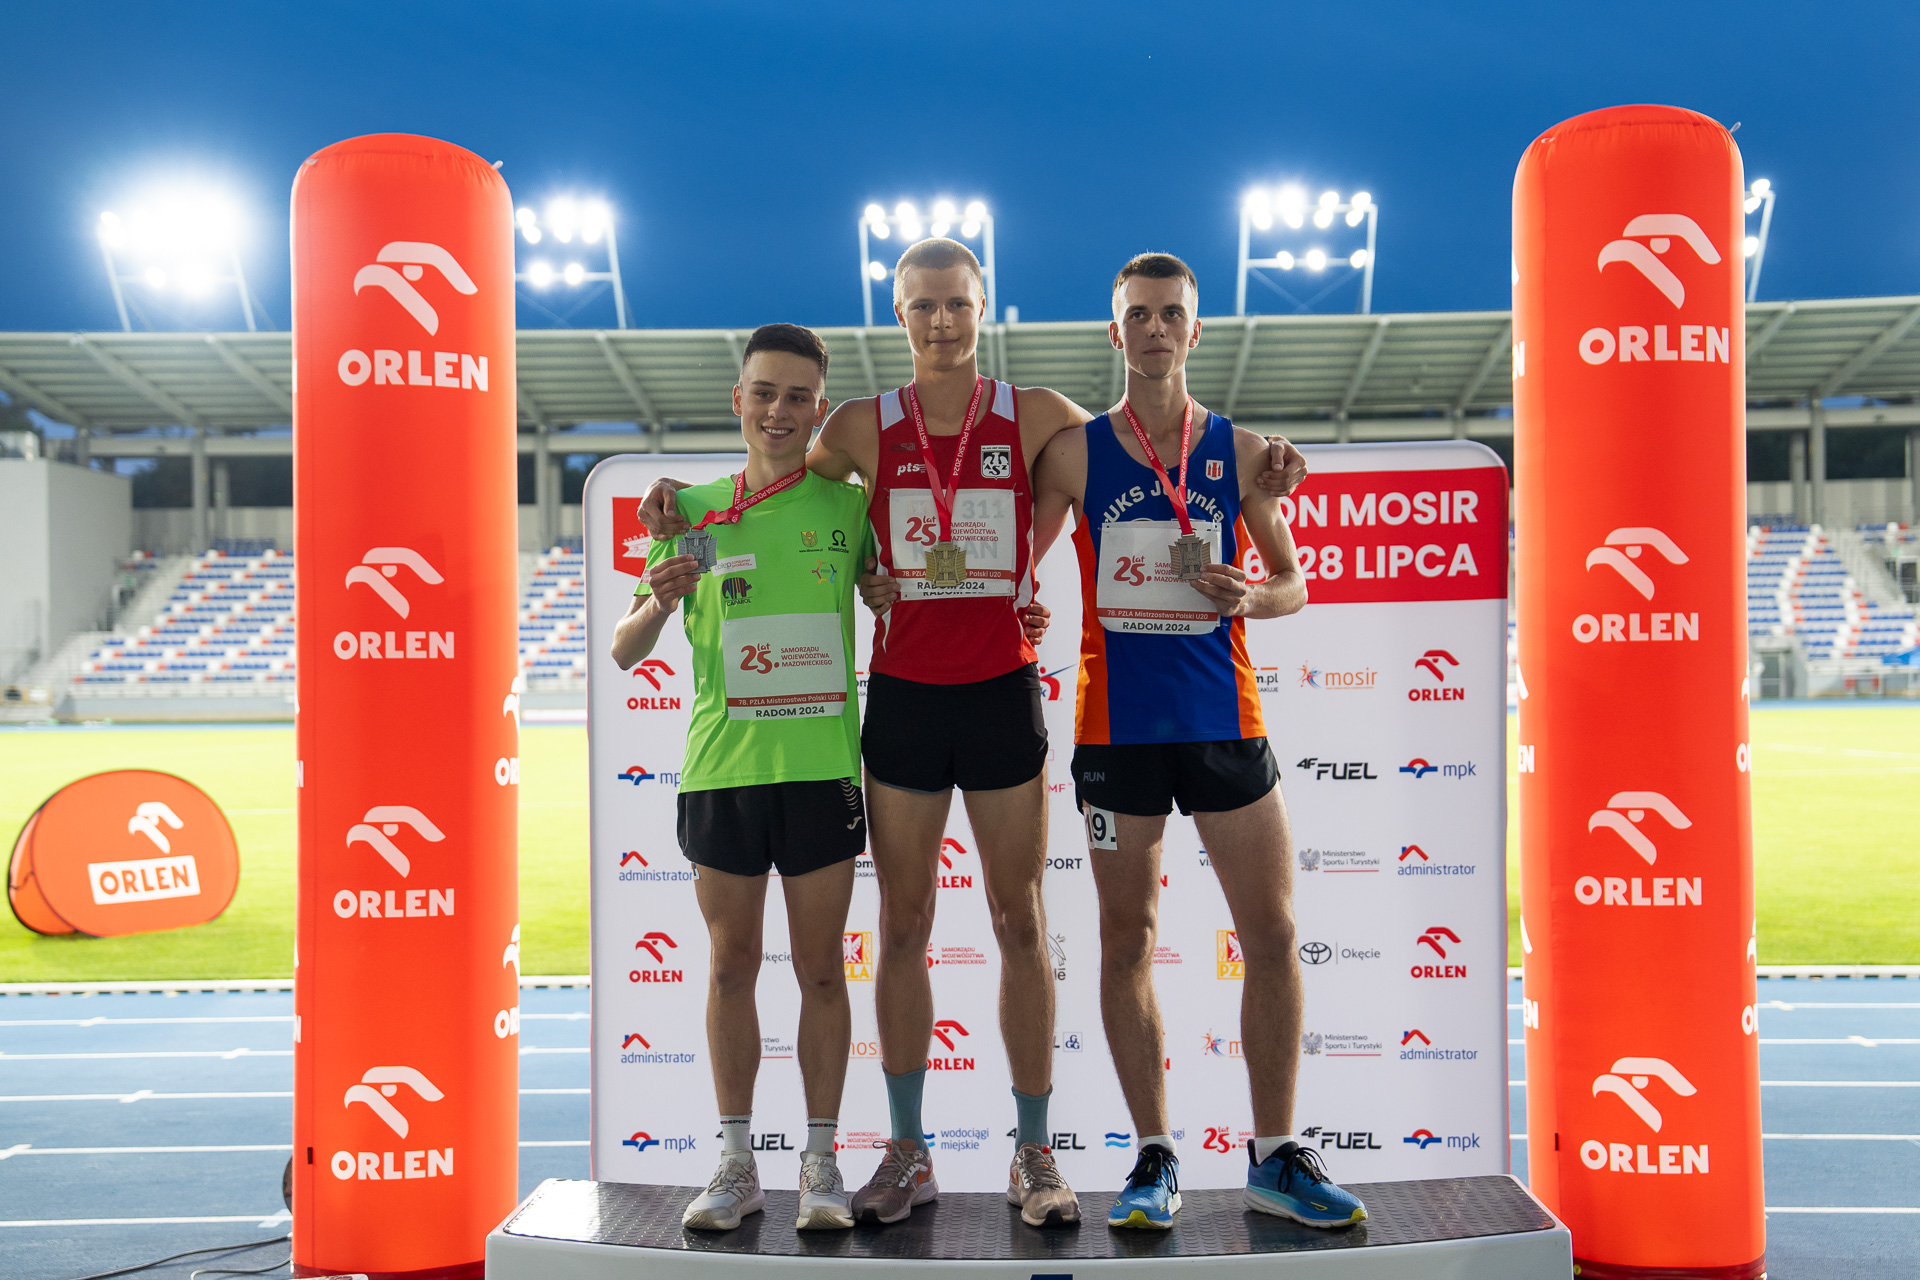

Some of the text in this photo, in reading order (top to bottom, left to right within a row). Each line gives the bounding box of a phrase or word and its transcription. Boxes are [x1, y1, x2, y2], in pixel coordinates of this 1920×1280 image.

[1578, 324, 1729, 365] ORLEN
[338, 349, 488, 392] ORLEN
[1151, 481, 1224, 522] Jynka
[1340, 491, 1478, 526] MOSIR
[923, 516, 936, 524] lat
[1356, 544, 1478, 579] LIPCA
[960, 582, 985, 590] 2024
[1176, 612, 1194, 620] Polski
[1123, 622, 1190, 632] RADOM 2024
[1572, 612, 1698, 643] ORLEN
[334, 631, 454, 660] ORLEN
[781, 646, 820, 654] SAMORZĄDU
[781, 652, 830, 660] WOJEWÓDZTWA
[1326, 667, 1378, 685] mosir
[1408, 688, 1464, 702] ORLEN
[627, 698, 680, 710] ORLEN
[750, 698, 766, 706] PZLA
[756, 706, 824, 718] RADOM 2024
[1316, 762, 1378, 780] FUEL
[1444, 761, 1476, 780] mpk
[1083, 772, 1104, 782] RUN
[1322, 858, 1344, 867] Sportu
[1350, 858, 1380, 867] Turystyki
[619, 870, 692, 881] administrator
[1398, 864, 1476, 876] administrator
[100, 864, 190, 895] ORLEN
[1574, 876, 1702, 906] ORLEN
[334, 888, 454, 918] ORLEN
[1342, 948, 1380, 960] Okęcie
[629, 970, 682, 982] ORLEN
[1410, 966, 1466, 978] ORLEN
[1325, 1042, 1346, 1050] Sportu
[1352, 1042, 1382, 1051] Turystyki
[620, 1052, 696, 1063] administrator
[1400, 1048, 1478, 1060] administrator
[940, 1128, 989, 1140] wodociągi
[664, 1135, 696, 1152] mpk
[751, 1134, 794, 1150] UEL
[940, 1140, 980, 1152] miejskie
[1321, 1132, 1382, 1150] FUEL
[1448, 1133, 1480, 1151] mpk
[1580, 1140, 1708, 1174] ORLEN
[331, 1148, 453, 1180] ORLEN
